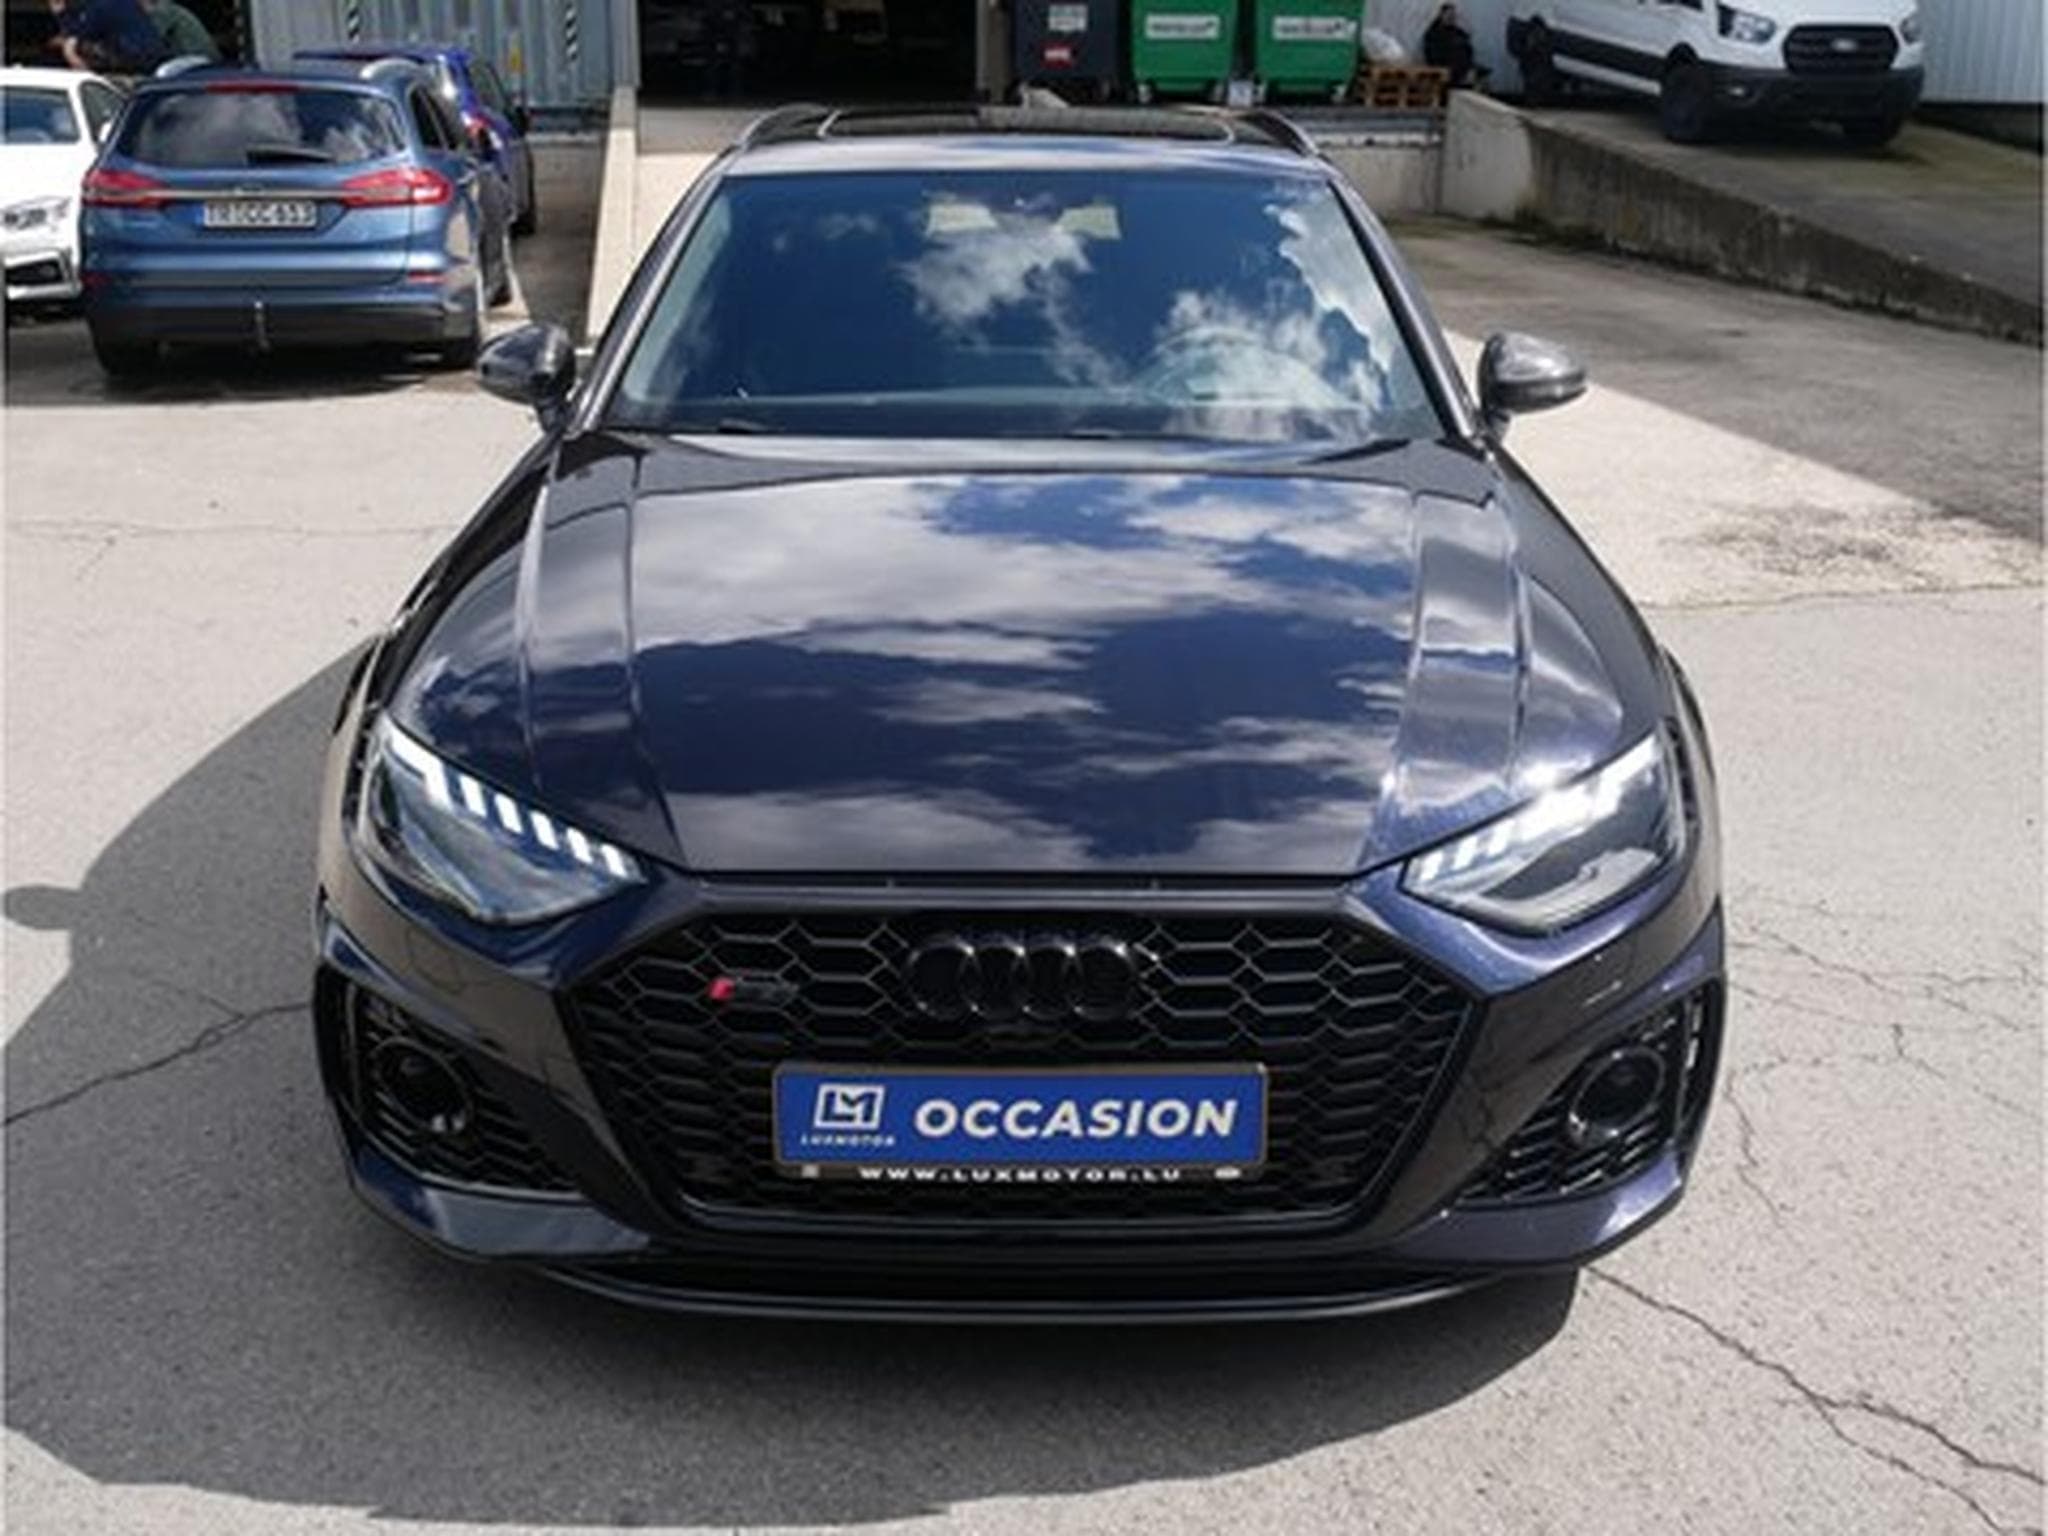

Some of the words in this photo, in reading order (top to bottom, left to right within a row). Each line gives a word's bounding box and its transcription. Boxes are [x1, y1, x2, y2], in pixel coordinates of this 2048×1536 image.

[915, 1099, 1238, 1138] OCCASION
[801, 1134, 895, 1147] LUXMOTOR
[857, 1166, 1181, 1182] WWW.LUXMOTOR.LU
